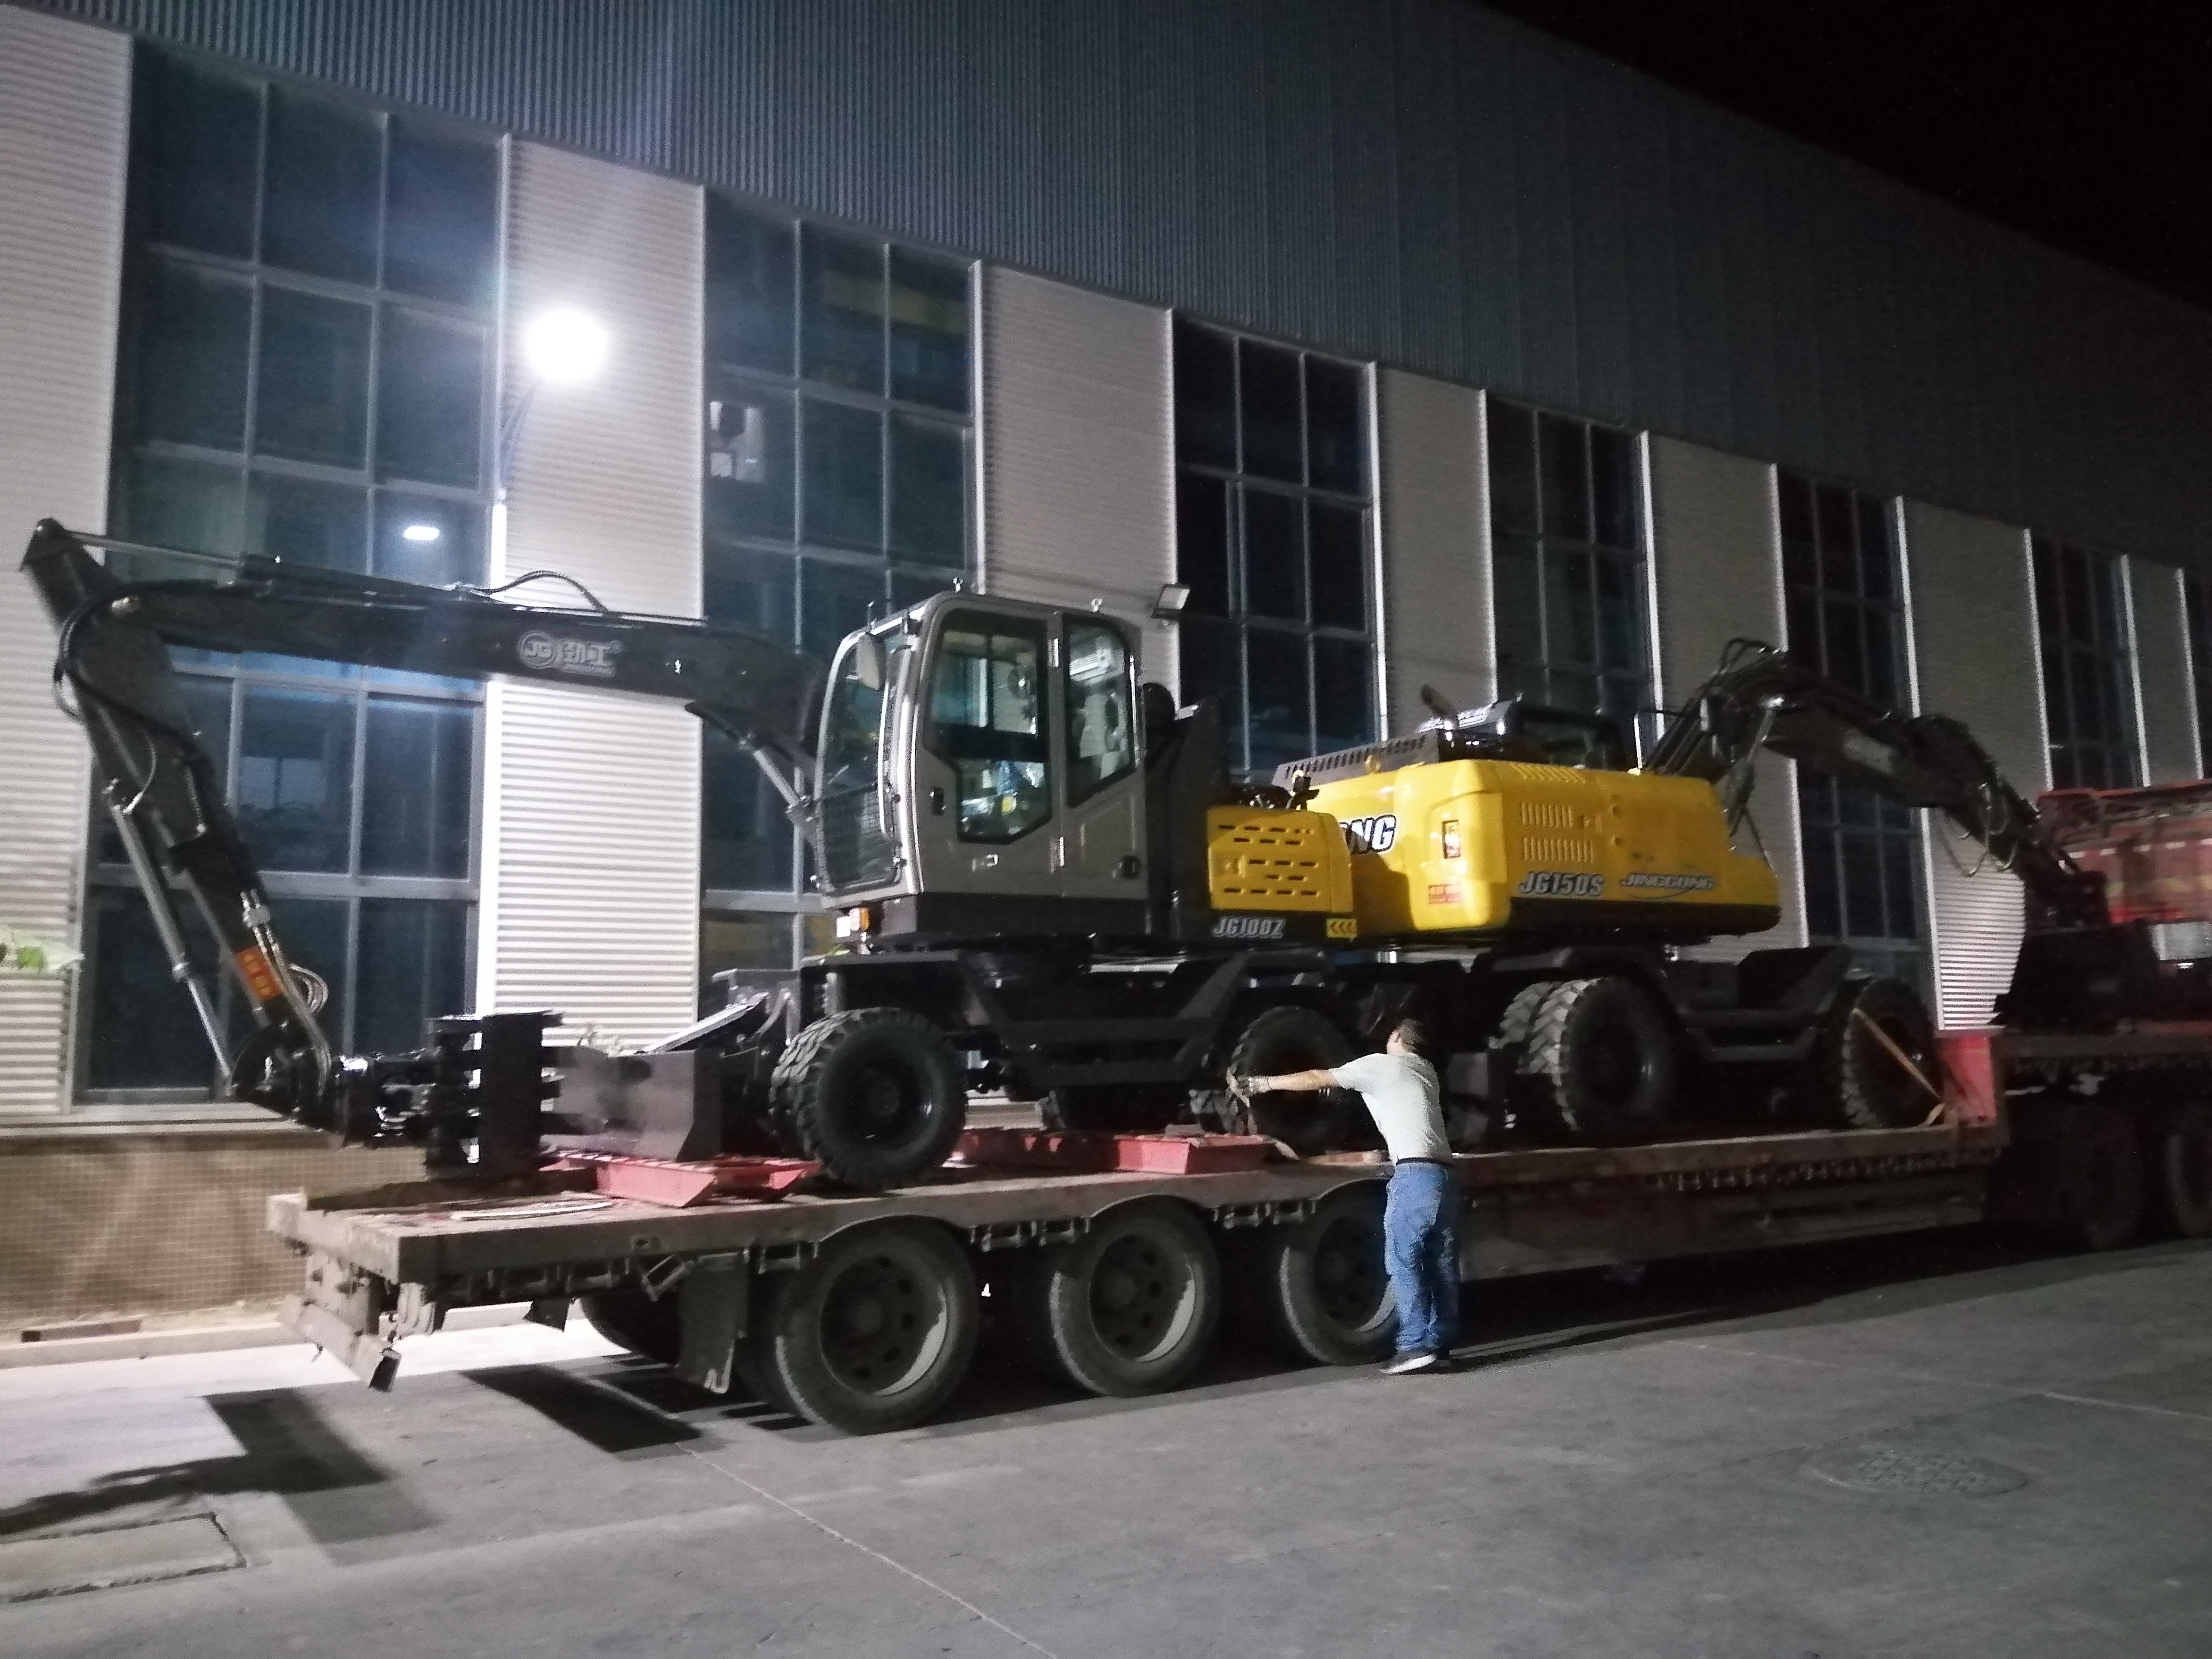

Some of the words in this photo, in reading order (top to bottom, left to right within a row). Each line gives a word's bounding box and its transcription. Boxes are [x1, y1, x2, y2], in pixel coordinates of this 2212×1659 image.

[1340, 814, 1396, 855] NG
[1519, 871, 1604, 896] JG150S
[1212, 917, 1286, 939] JG100Z
